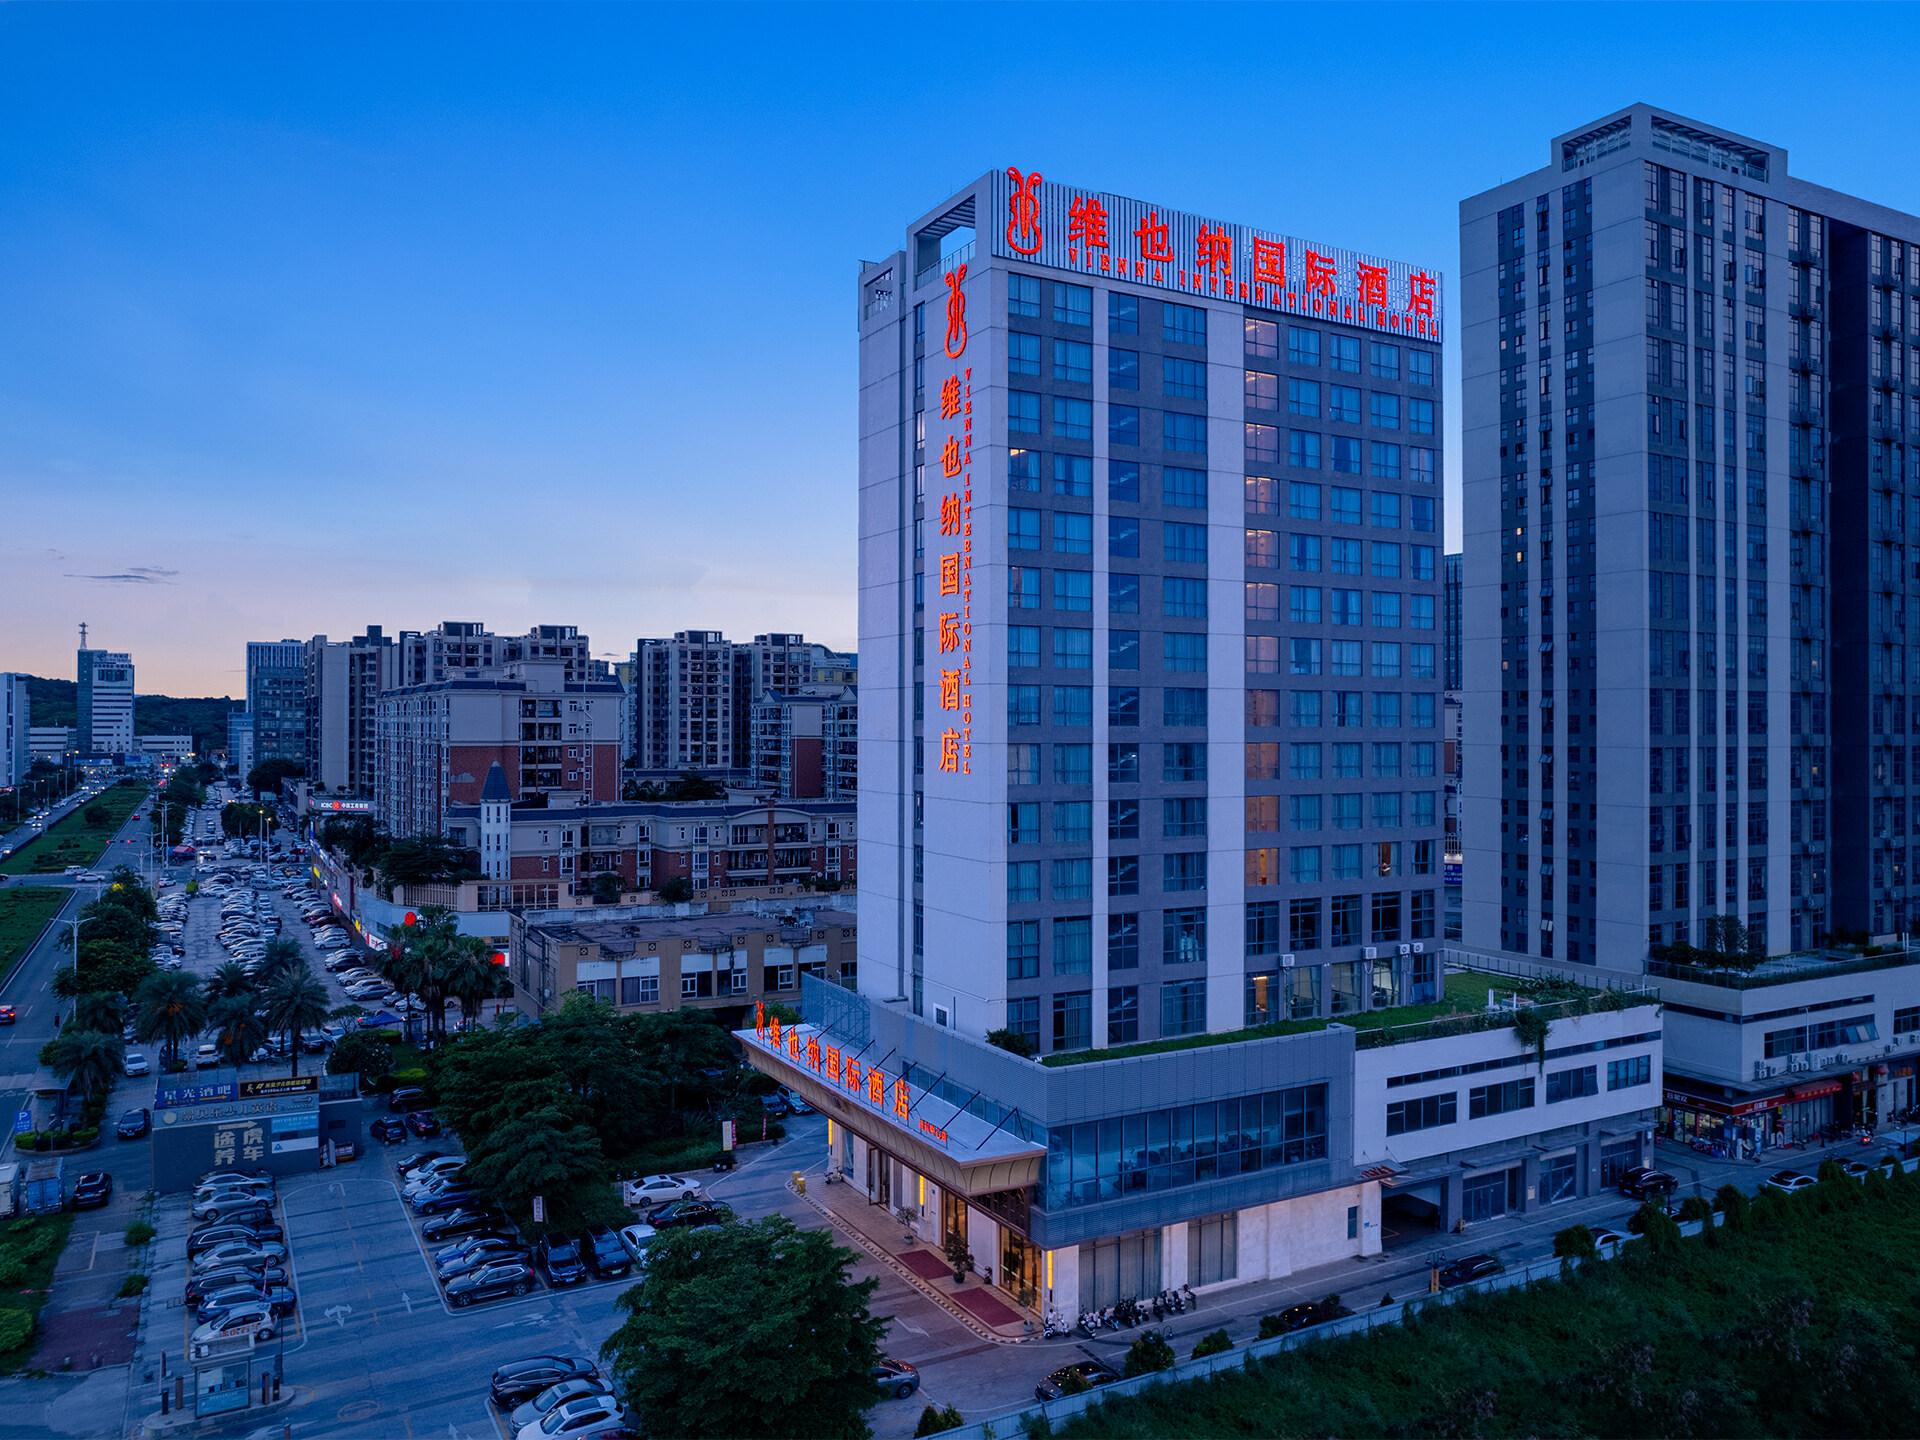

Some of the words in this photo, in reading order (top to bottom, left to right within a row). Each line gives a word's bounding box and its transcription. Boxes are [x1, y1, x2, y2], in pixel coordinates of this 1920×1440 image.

[1068, 195, 1436, 318] 维也纳国际酒店
[1069, 247, 1163, 281] VIENNA
[1180, 269, 1366, 322] INTERNATIONAL
[1377, 310, 1438, 337] HOTEL
[963, 367, 972, 465] VIENNA
[939, 374, 961, 773] 维也纳国际酒店
[963, 473, 972, 686] INTERNATIONAL
[962, 693, 971, 775] HOTEL
[18, 1111, 28, 1121] P
[164, 1084, 232, 1101] 星光酒吧
[769, 1015, 911, 1121] 维也纳国际酒店
